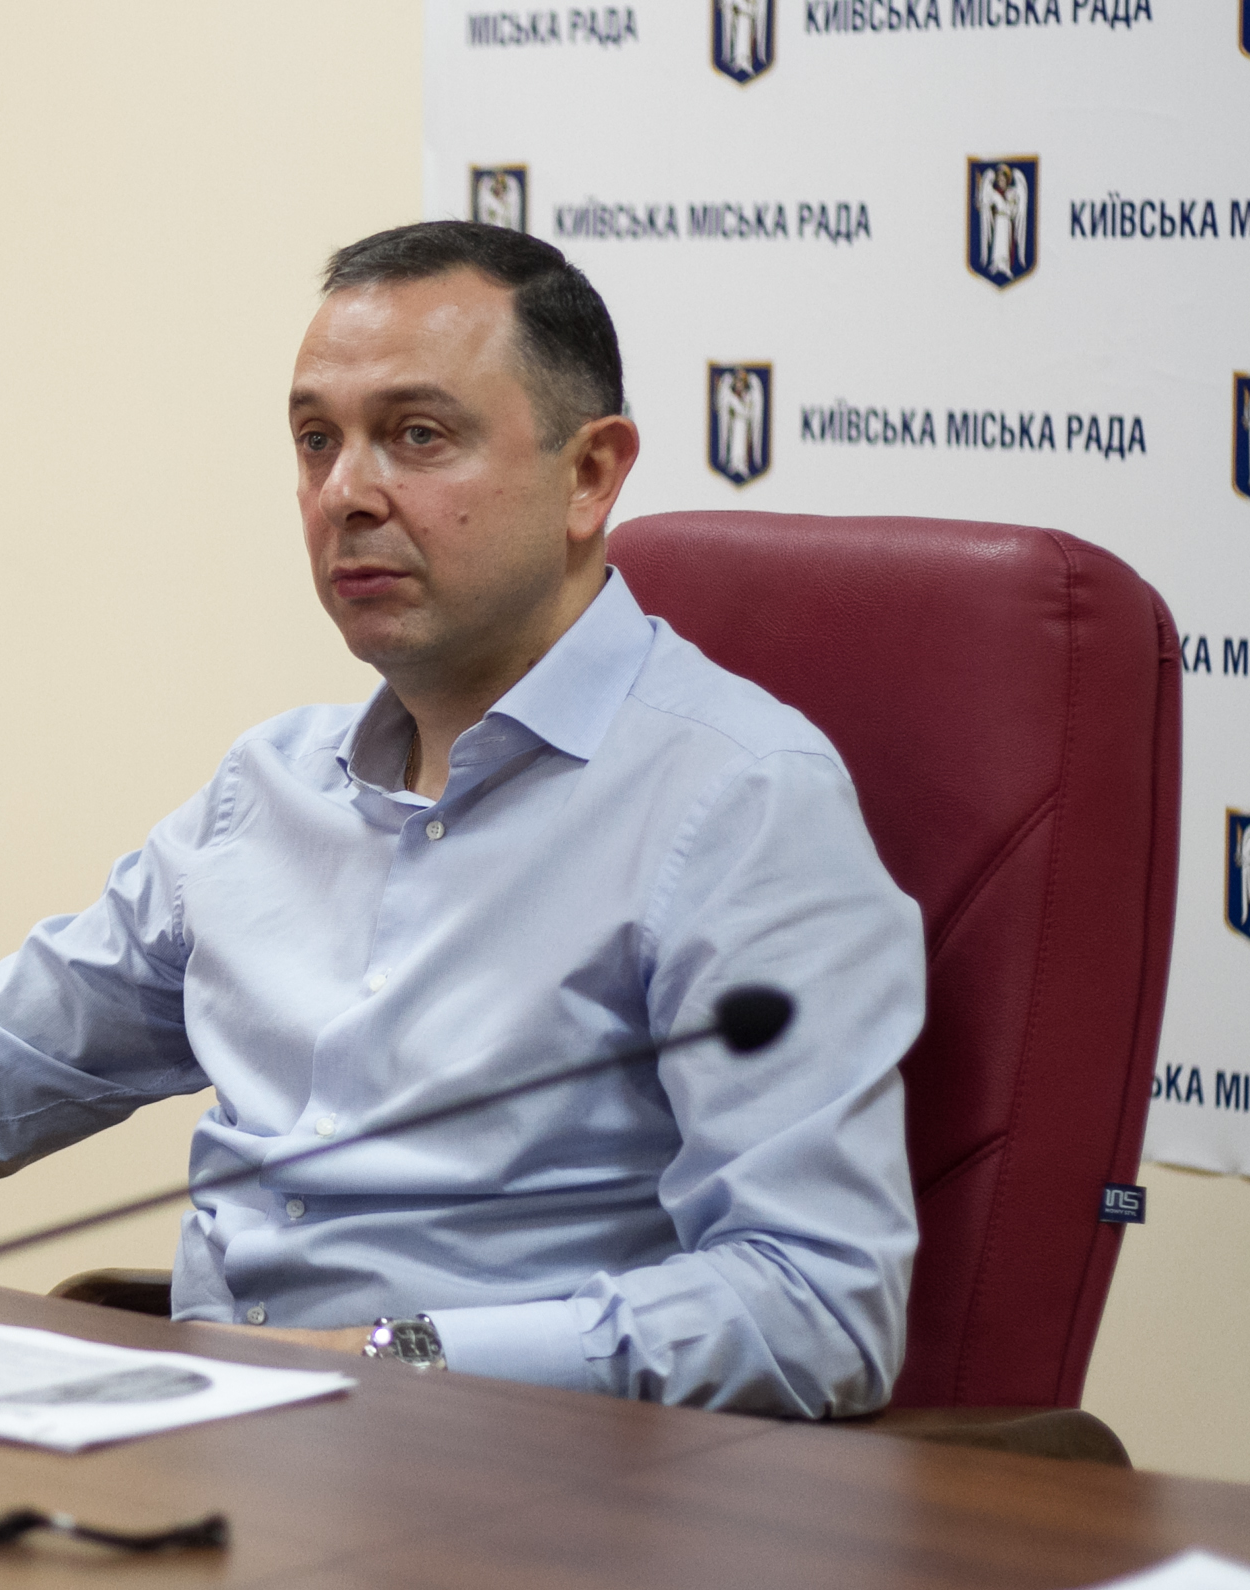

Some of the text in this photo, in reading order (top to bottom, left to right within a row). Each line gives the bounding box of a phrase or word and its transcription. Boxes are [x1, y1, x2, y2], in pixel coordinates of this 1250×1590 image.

[468, 6, 638, 49] МІСЬКА РАДА
[951, 0, 1062, 30] МІСЬКА
[553, 194, 872, 245] КИЇВСЬКА МІСЬКА РАДА
[1070, 190, 1219, 238] КИЇВСЬКА
[800, 397, 1147, 460] КИЇВСЬКА МІСЬКА РАДА
